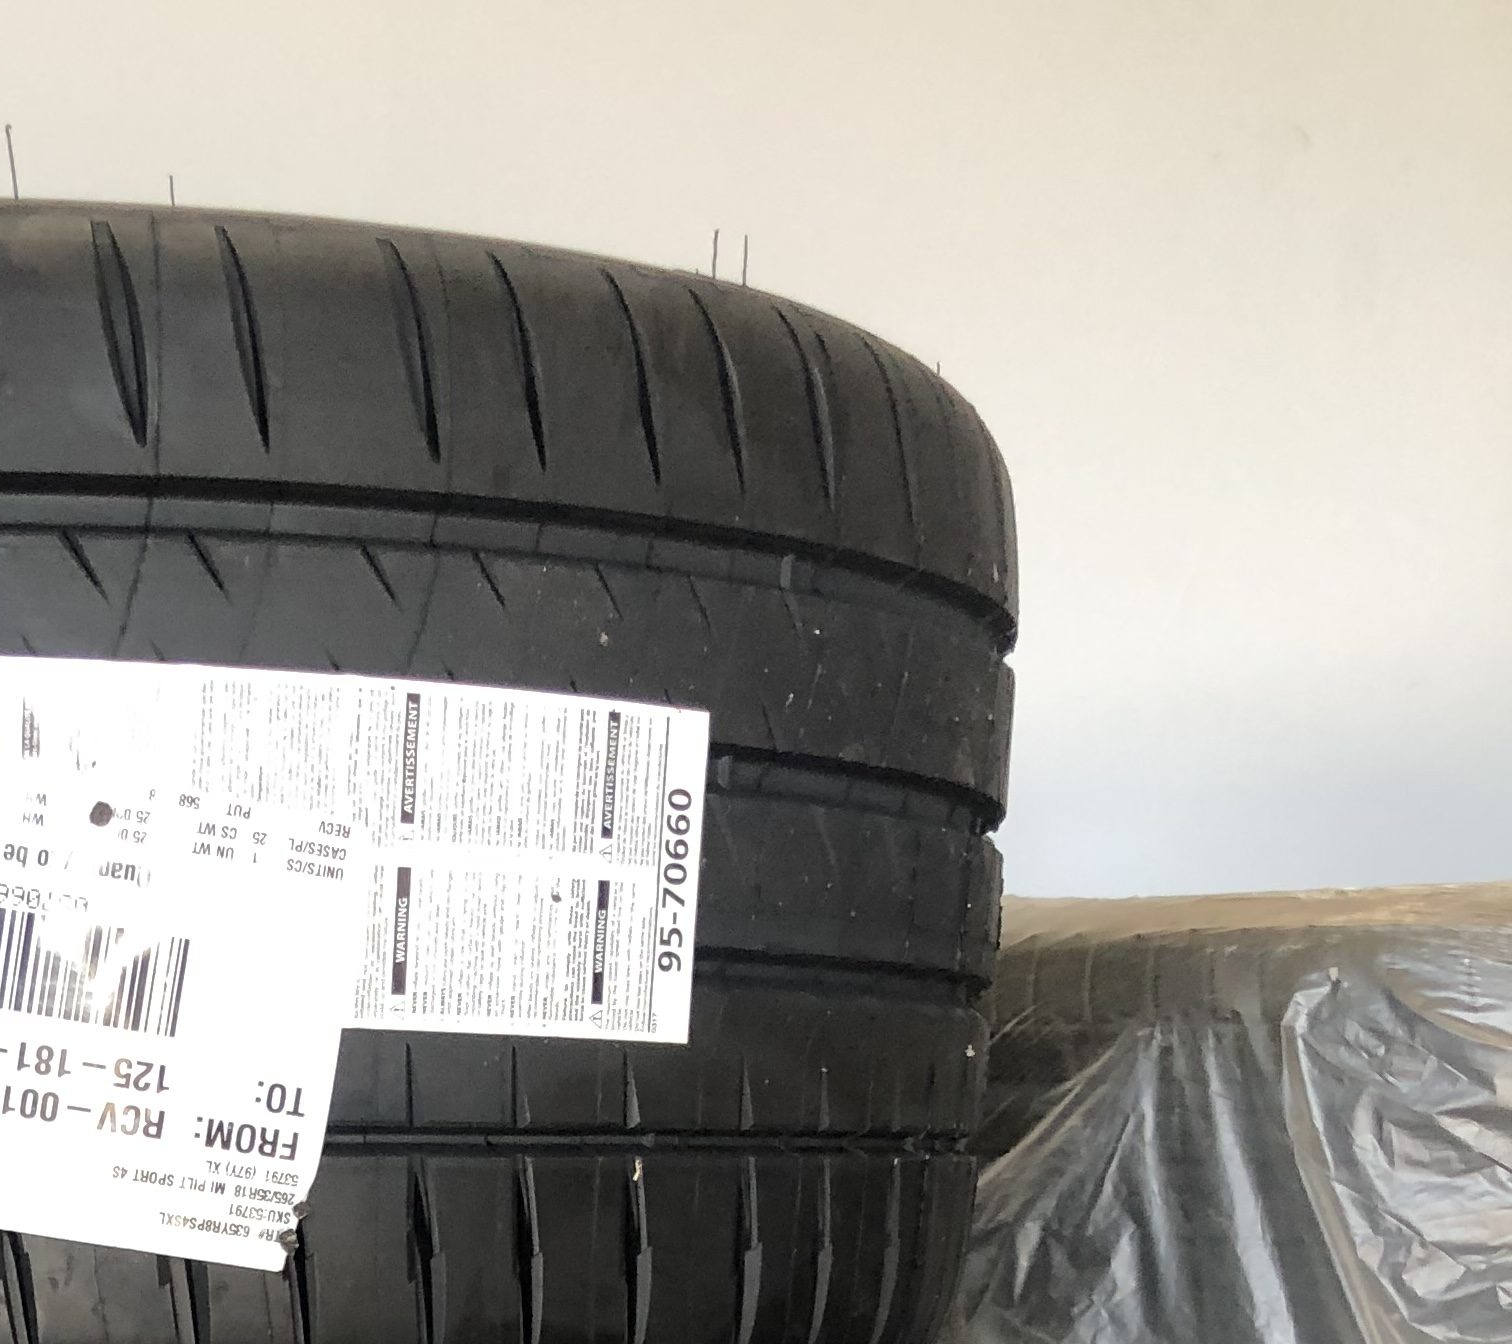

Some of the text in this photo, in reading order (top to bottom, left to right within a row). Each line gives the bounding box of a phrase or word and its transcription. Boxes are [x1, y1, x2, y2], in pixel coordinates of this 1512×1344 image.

[178, 794, 351, 838] RECV PUT 568
[395, 701, 419, 963] WARNING AVERTISSEMENT
[3, 843, 28, 868] be
[196, 821, 347, 861] CASES/PL 25 CS WT
[594, 720, 619, 973] WARNING AVERTISSEMENT
[191, 842, 344, 881] UNITS/CS 1 UN WT
[657, 787, 693, 973] 95-70660
[255, 1079, 307, 1117] TO:
[192, 1115, 301, 1161] FROM:
[112, 1165, 295, 1205] 265/35R18 MI PILT SPORT 4S
[206, 1160, 299, 1186] 53791 (97Y) XL
[229, 1204, 290, 1224] SKU:53791
